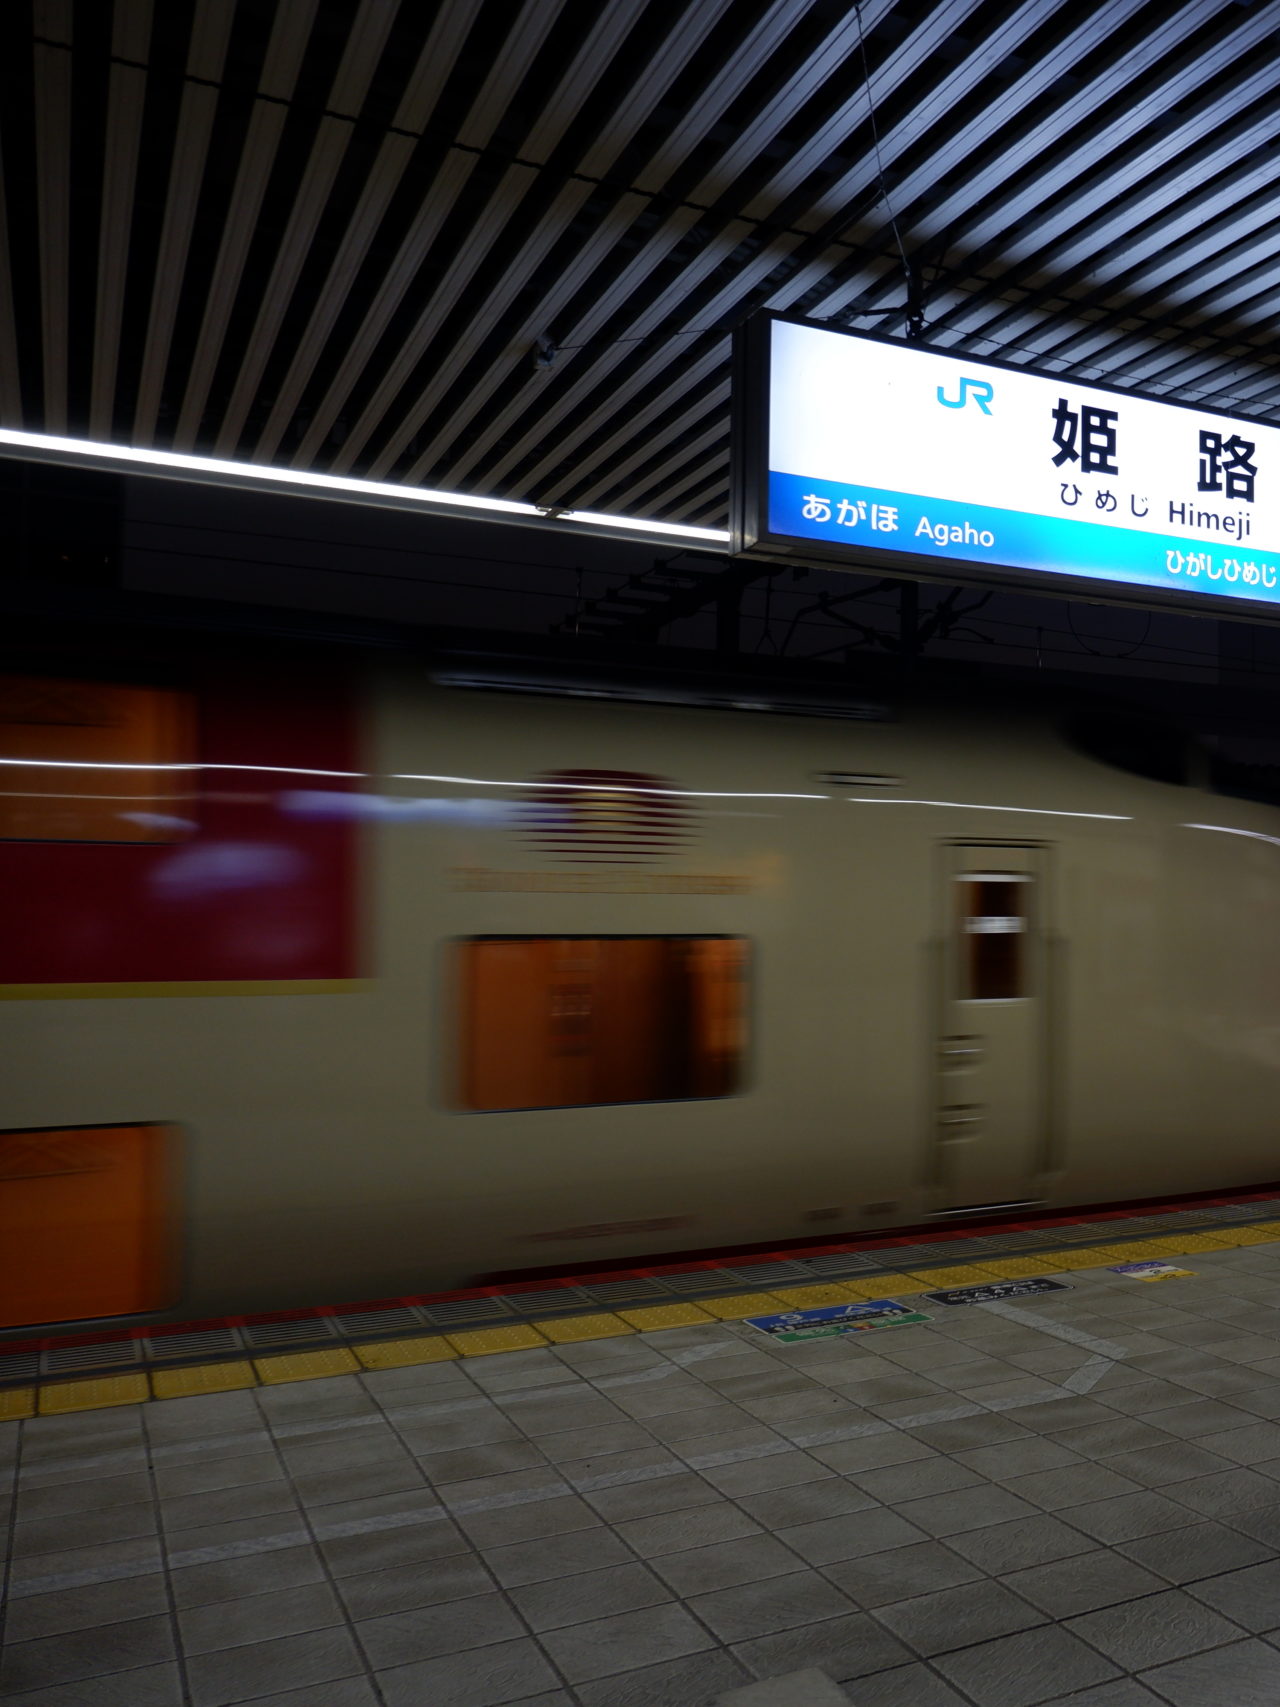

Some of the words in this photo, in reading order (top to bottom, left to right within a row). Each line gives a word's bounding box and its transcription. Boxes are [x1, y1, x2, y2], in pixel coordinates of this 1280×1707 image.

[937, 377, 994, 415] JR
[802, 494, 898, 532] あがほ
[915, 518, 995, 548] Agaho
[1060, 483, 1149, 517] ひめじ
[1168, 501, 1252, 540] Himeji
[1166, 550, 1277, 588] ひがしひめじ
